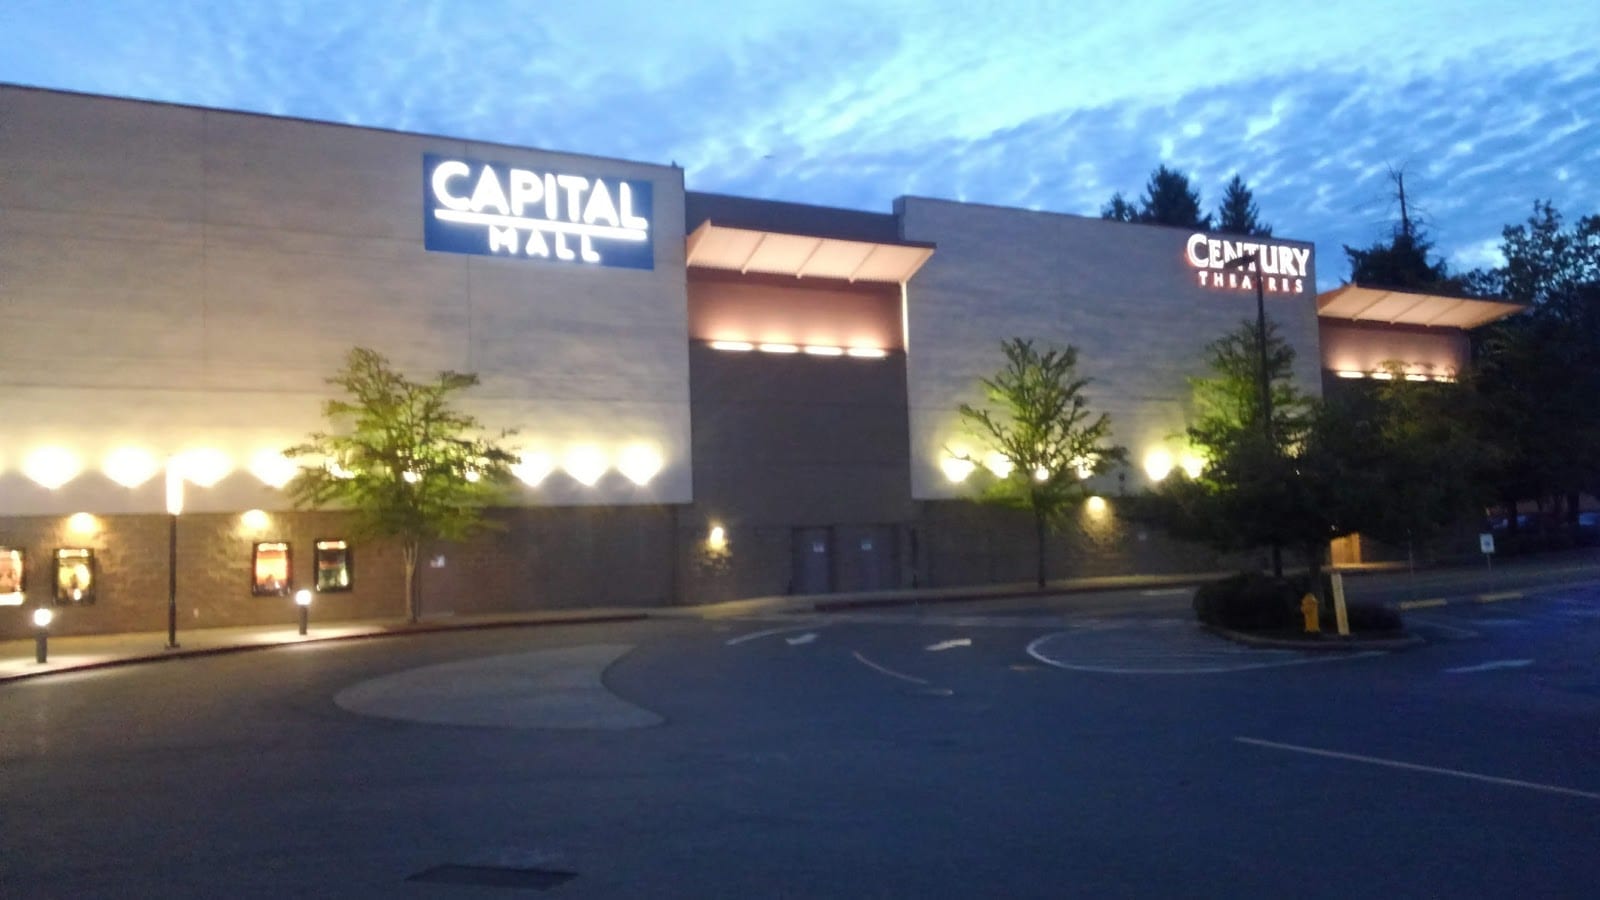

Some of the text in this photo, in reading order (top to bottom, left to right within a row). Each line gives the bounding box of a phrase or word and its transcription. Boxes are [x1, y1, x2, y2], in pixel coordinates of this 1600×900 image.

[432, 161, 648, 229] CAPITAL
[488, 224, 600, 262] MALL
[1186, 233, 1310, 277] CENTURY
[1198, 270, 1303, 293] THEARES
